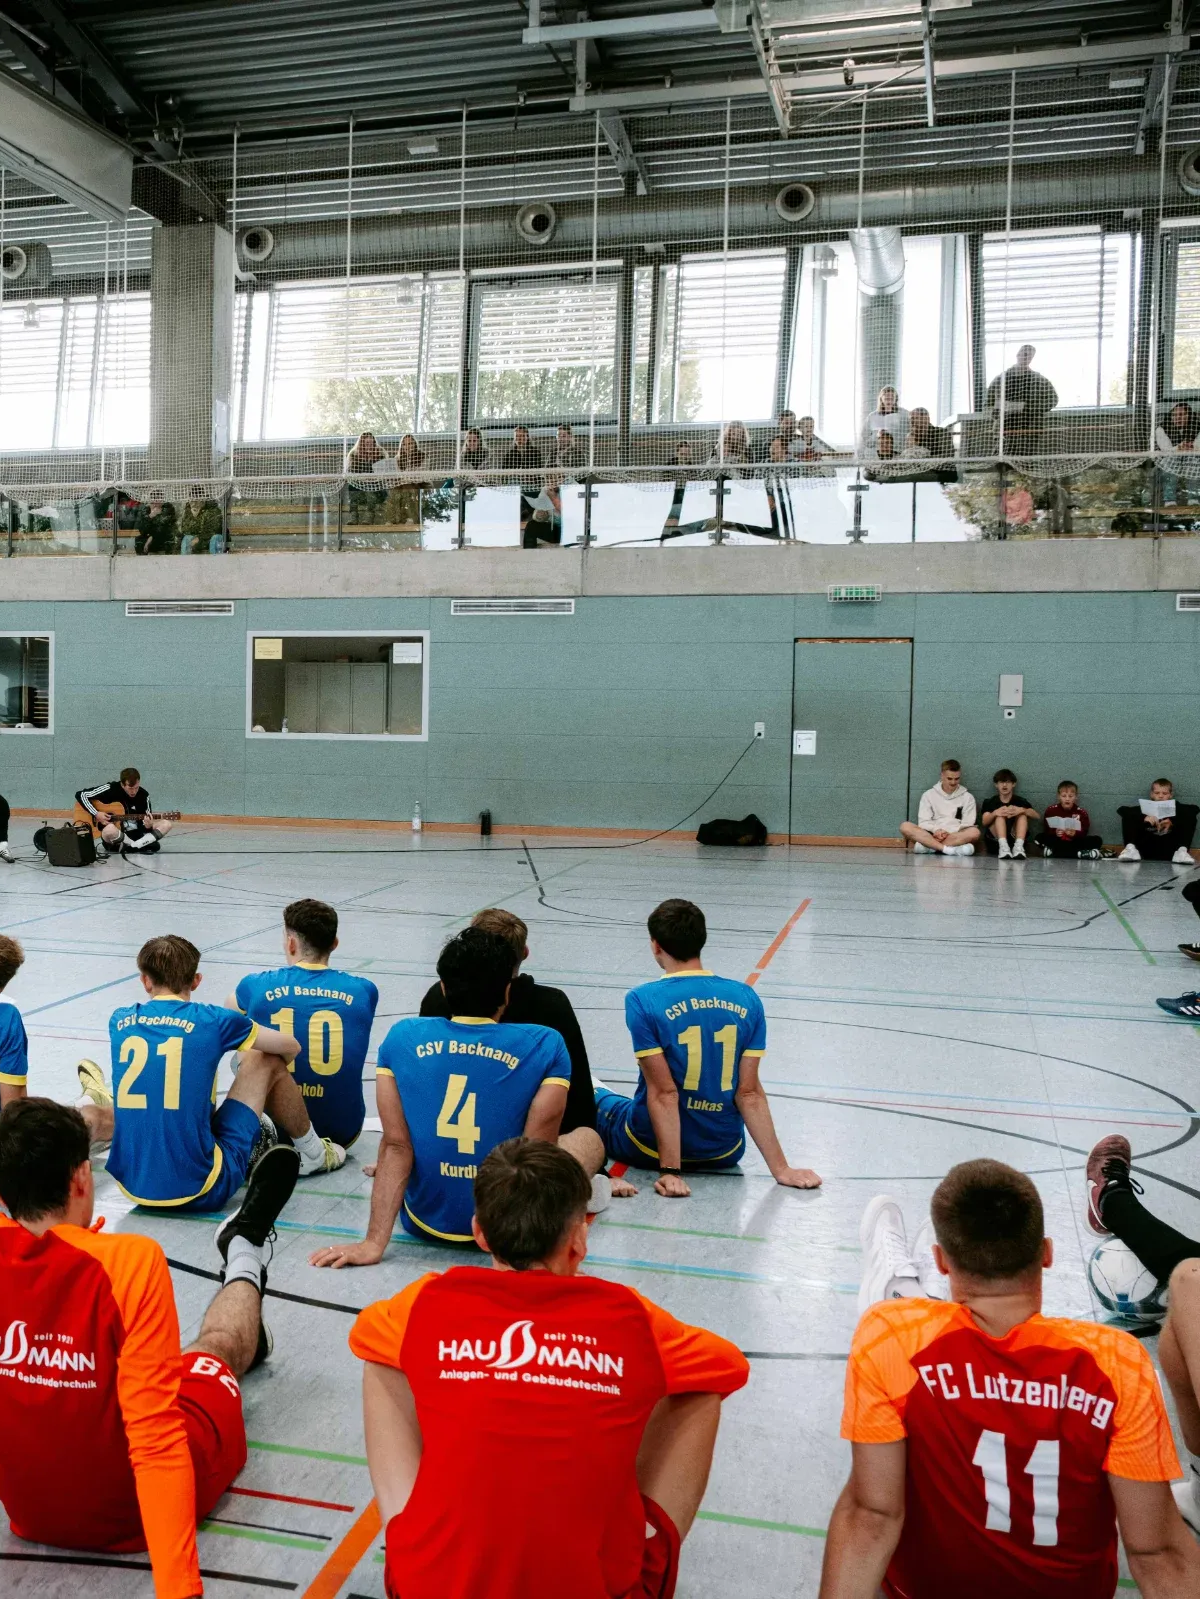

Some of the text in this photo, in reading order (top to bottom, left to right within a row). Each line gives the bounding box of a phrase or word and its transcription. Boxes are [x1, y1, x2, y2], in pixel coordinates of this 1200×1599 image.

[265, 985, 354, 1006] CSV Backnang
[664, 996, 748, 1021] CSV Backnang
[117, 1013, 195, 1033] CSV Backnang
[270, 1007, 344, 1076] 10
[416, 1040, 519, 1070] CSV Backnang
[677, 1024, 738, 1092] 11
[117, 1035, 184, 1110] 21
[296, 1083, 324, 1098] akob
[436, 1073, 481, 1155] 4
[686, 1096, 724, 1112] Lukas
[34, 1332, 53, 1341] seit
[543, 1333, 598, 1346] seit 1921
[17, 1371, 97, 1389] Gebäudetechnik
[439, 1369, 621, 1396] Anlagen- und Gebäudetechnik
[918, 1362, 1115, 1430] FC Lutzenberg
[972, 1429, 1061, 1546] 11
